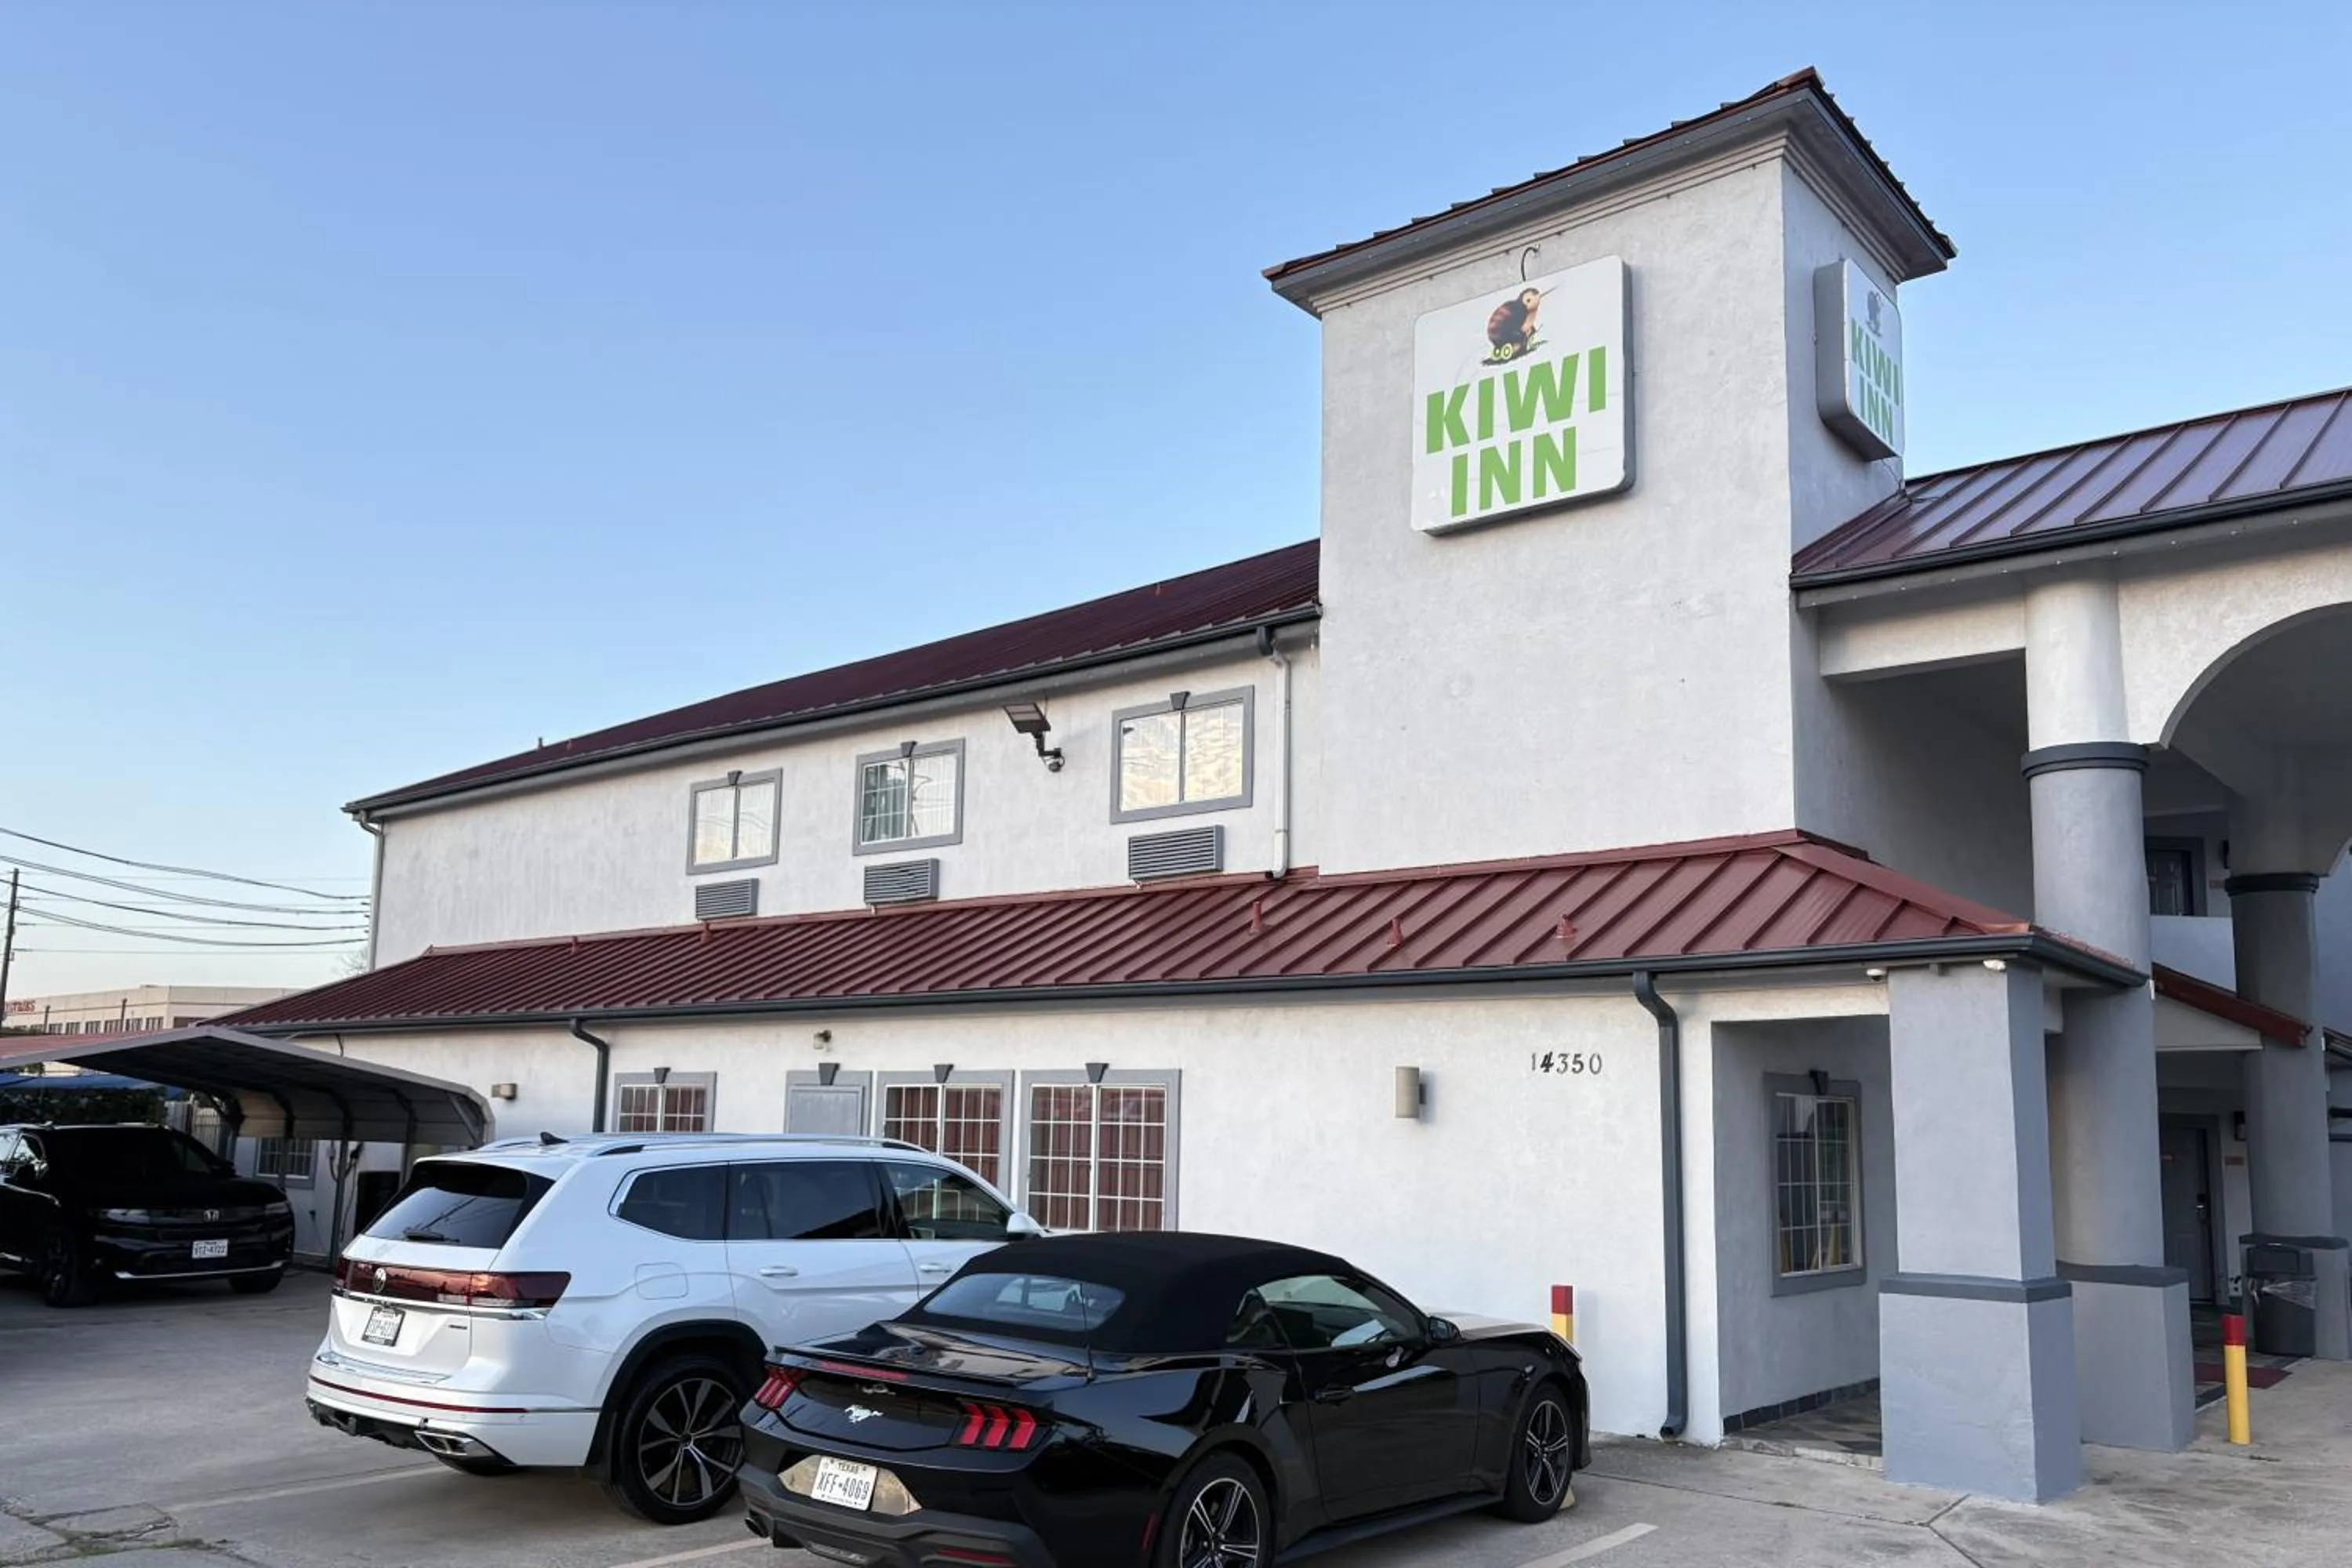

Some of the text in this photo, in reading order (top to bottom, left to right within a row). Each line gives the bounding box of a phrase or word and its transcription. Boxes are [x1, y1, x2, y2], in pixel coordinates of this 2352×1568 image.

[1426, 346, 1606, 454] KIWI
[1851, 317, 1900, 407] KIWI
[1859, 373, 1894, 446] INN
[1451, 426, 1577, 517] INN
[1531, 1051, 1602, 1075] 14350
